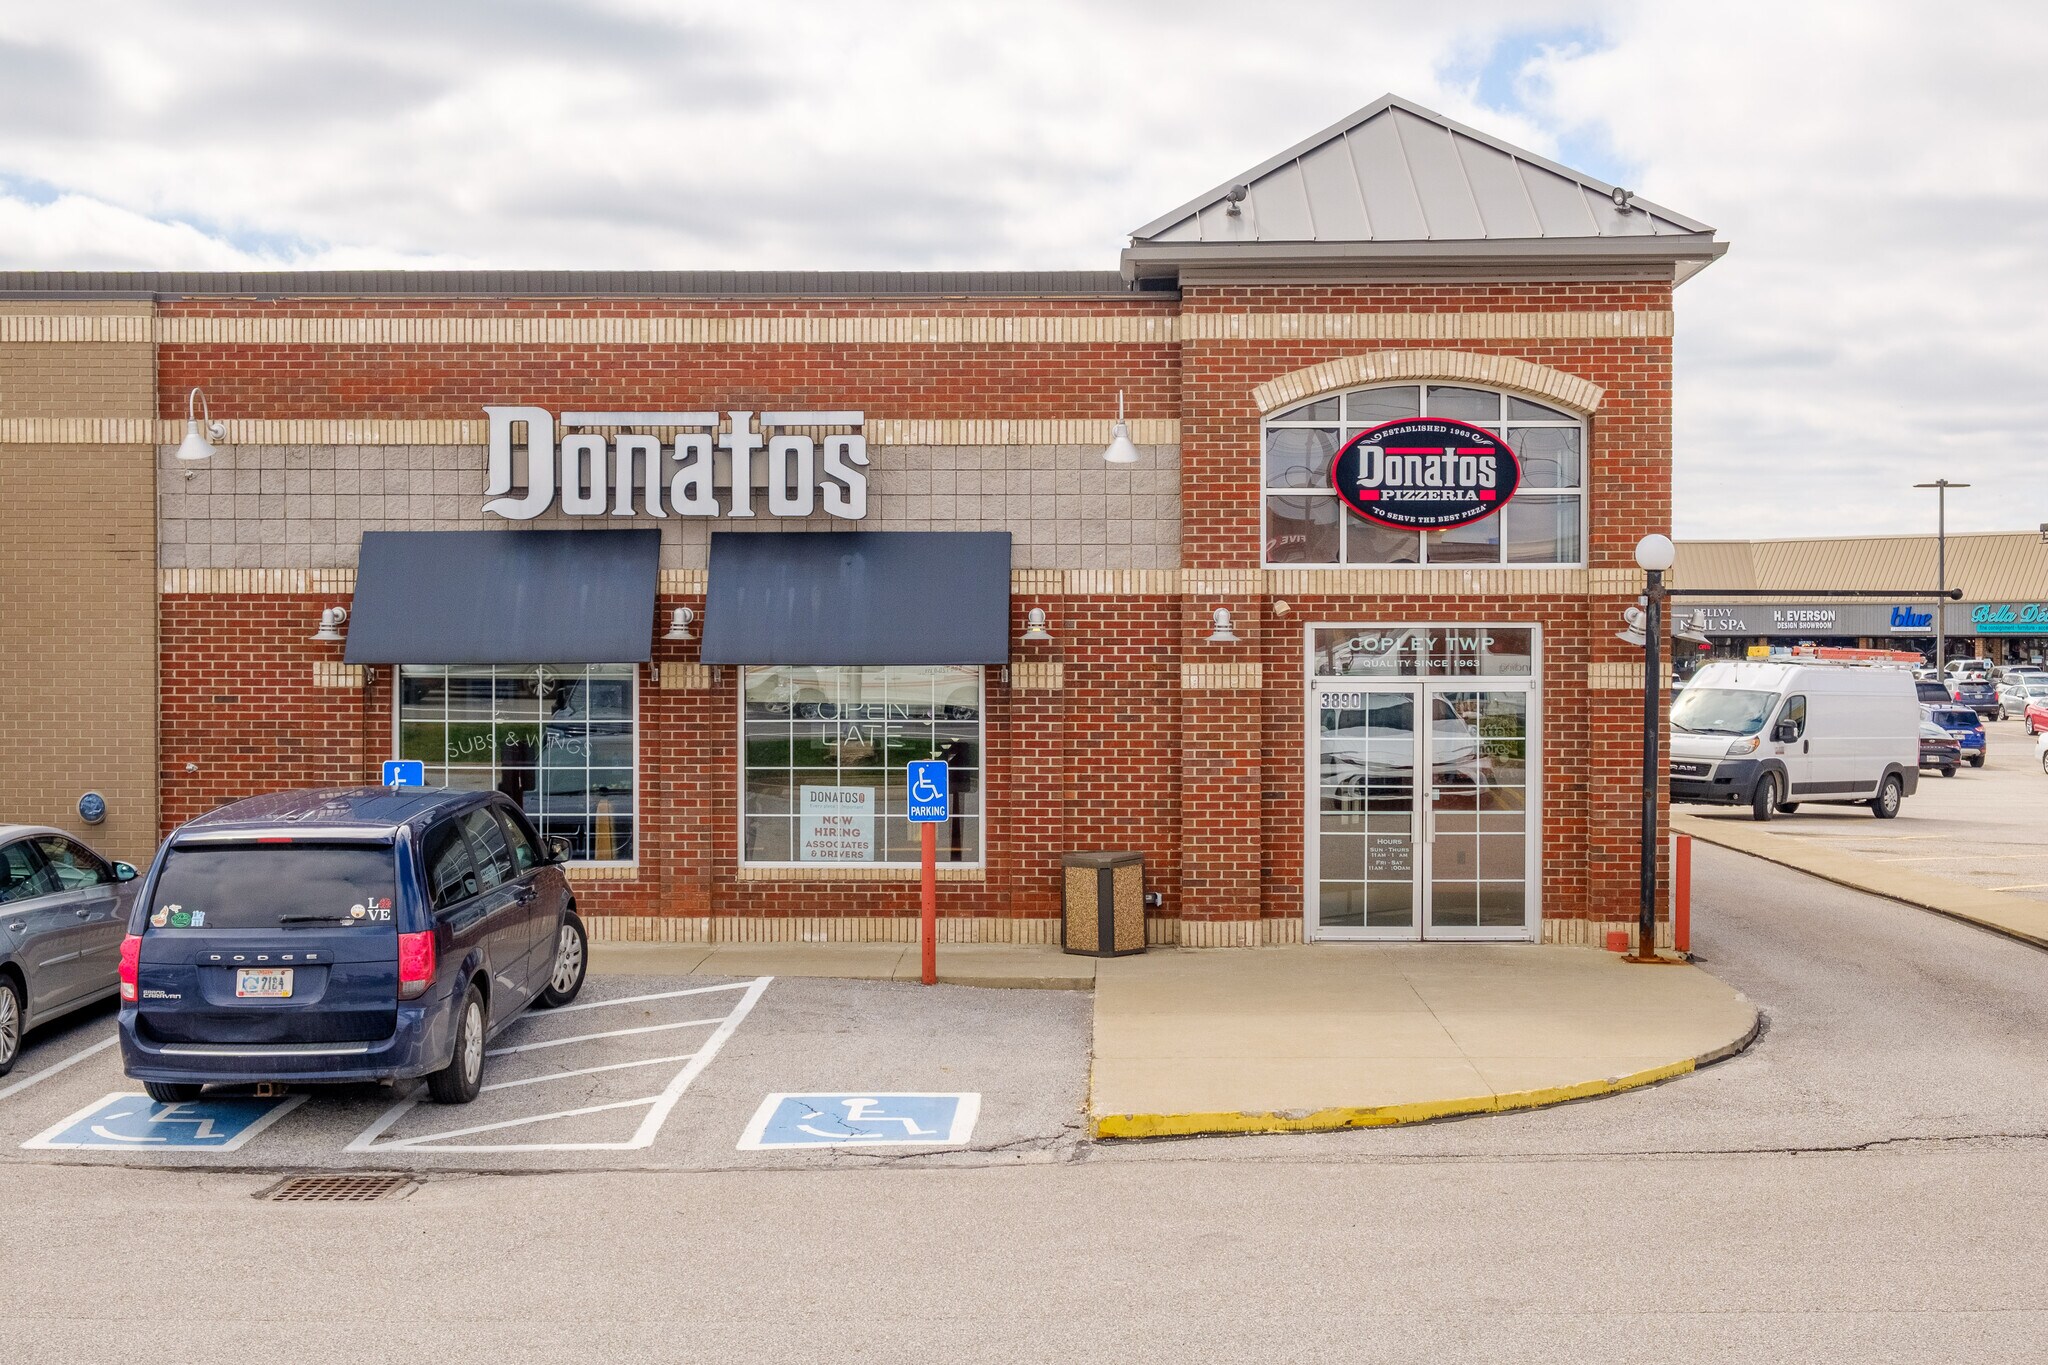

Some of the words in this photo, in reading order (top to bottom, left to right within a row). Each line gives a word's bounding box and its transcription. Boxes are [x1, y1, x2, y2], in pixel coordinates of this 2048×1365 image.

[1382, 425, 1447, 437] ESTABLISHED
[1450, 428, 1470, 438] 1963
[481, 405, 871, 520] Donatos
[1356, 445, 1497, 488] Donatos
[1380, 490, 1479, 501] PIZZERIA
[1387, 511, 1416, 523] SERVE
[1437, 513, 1460, 523] BEST
[1773, 610, 1784, 622] H.
[1787, 610, 1836, 622] EVERSON
[1890, 606, 1933, 627] blue
[1971, 604, 2018, 623] Bella
[1680, 619, 1716, 631] NIL
[1719, 619, 1747, 631] SPA
[1349, 637, 1438, 651] COPLEY
[1445, 637, 1495, 651] TWP
[1363, 660, 1411, 668] QUALITY
[1321, 693, 1361, 709] 3890
[817, 702, 909, 720] OPEN
[822, 724, 905, 747] LATE
[447, 733, 497, 758] SUBS
[505, 731, 519, 747] &
[810, 791, 858, 803] DONATOS
[911, 805, 946, 817] PARKING
[823, 816, 853, 825] NOW
[805, 840, 869, 849] ASSOCIATES
[811, 849, 817, 858] &
[820, 850, 864, 858] DRIVERS
